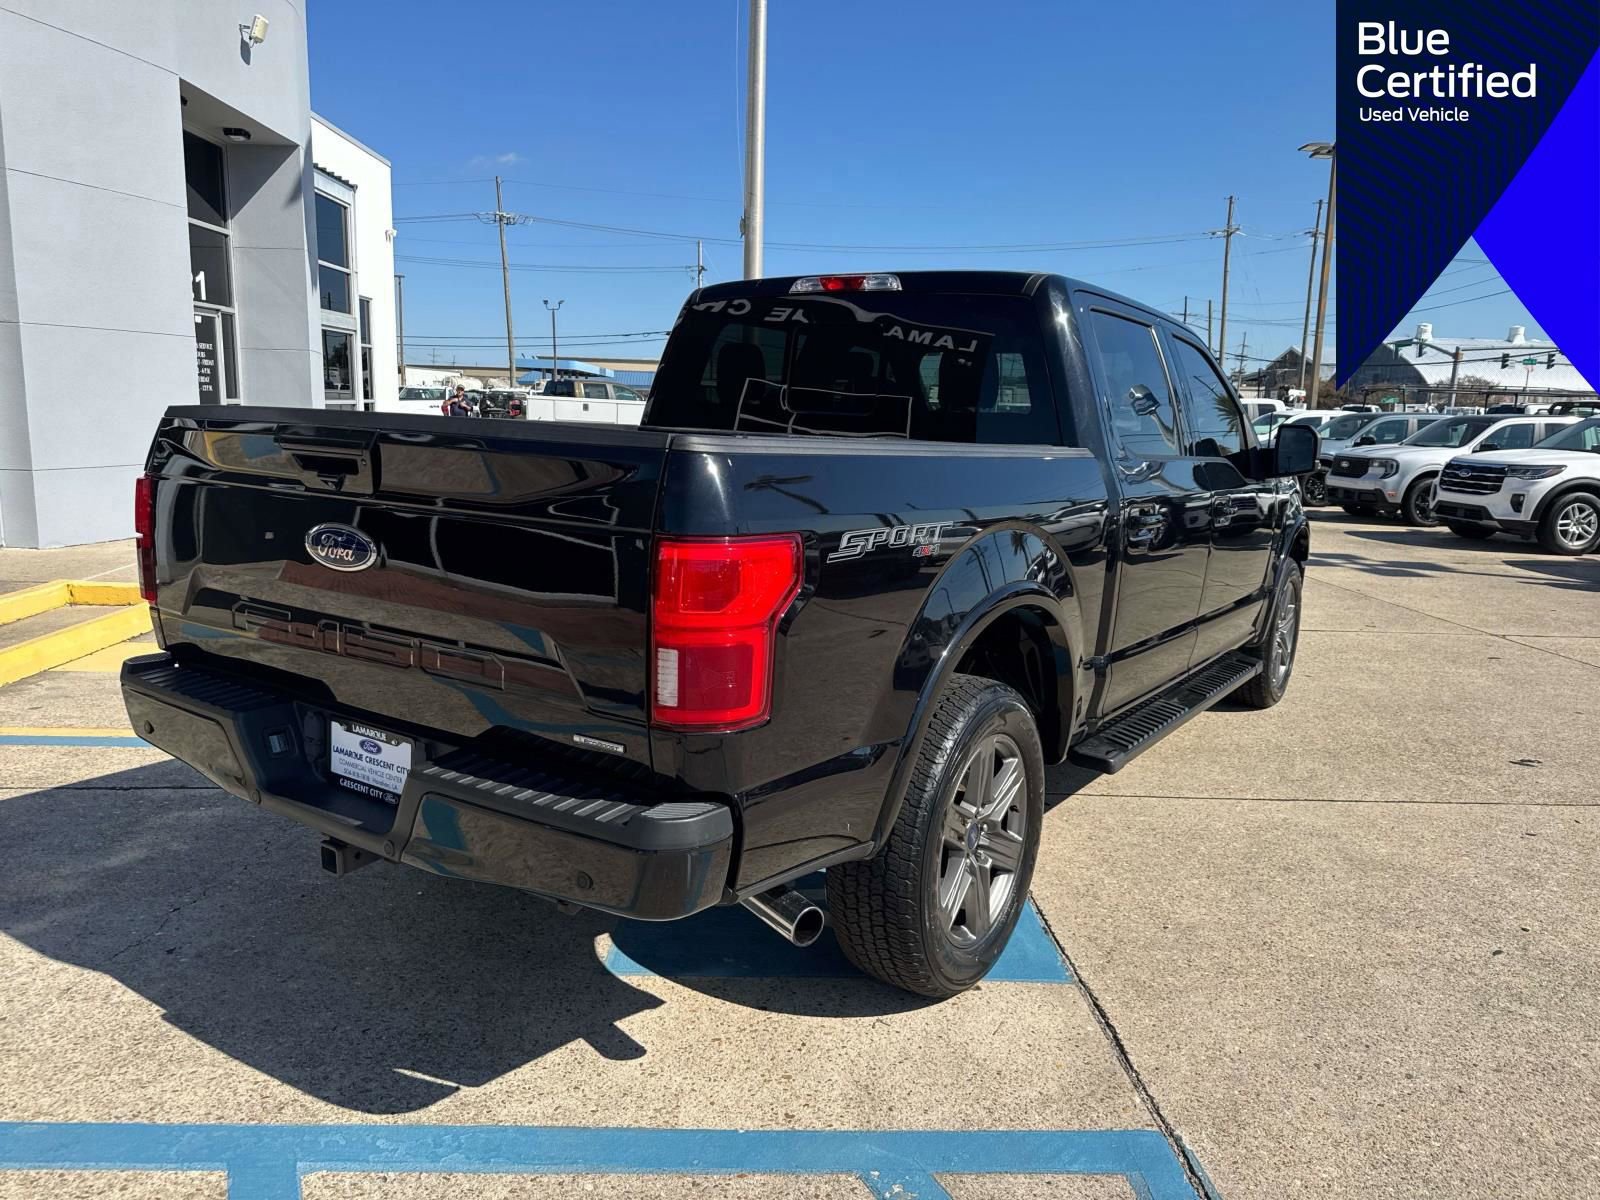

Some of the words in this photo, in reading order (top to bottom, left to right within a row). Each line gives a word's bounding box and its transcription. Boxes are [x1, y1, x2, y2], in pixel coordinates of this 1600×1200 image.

[826, 521, 953, 563] SPORT
[352, 723, 387, 741] LAMARQUE
[333, 744, 364, 761] LAMARQUE
[364, 755, 395, 772] CRESCENT
[396, 765, 410, 775] CITY
[340, 778, 369, 794] CRESCENT
[369, 787, 384, 799] CITY
